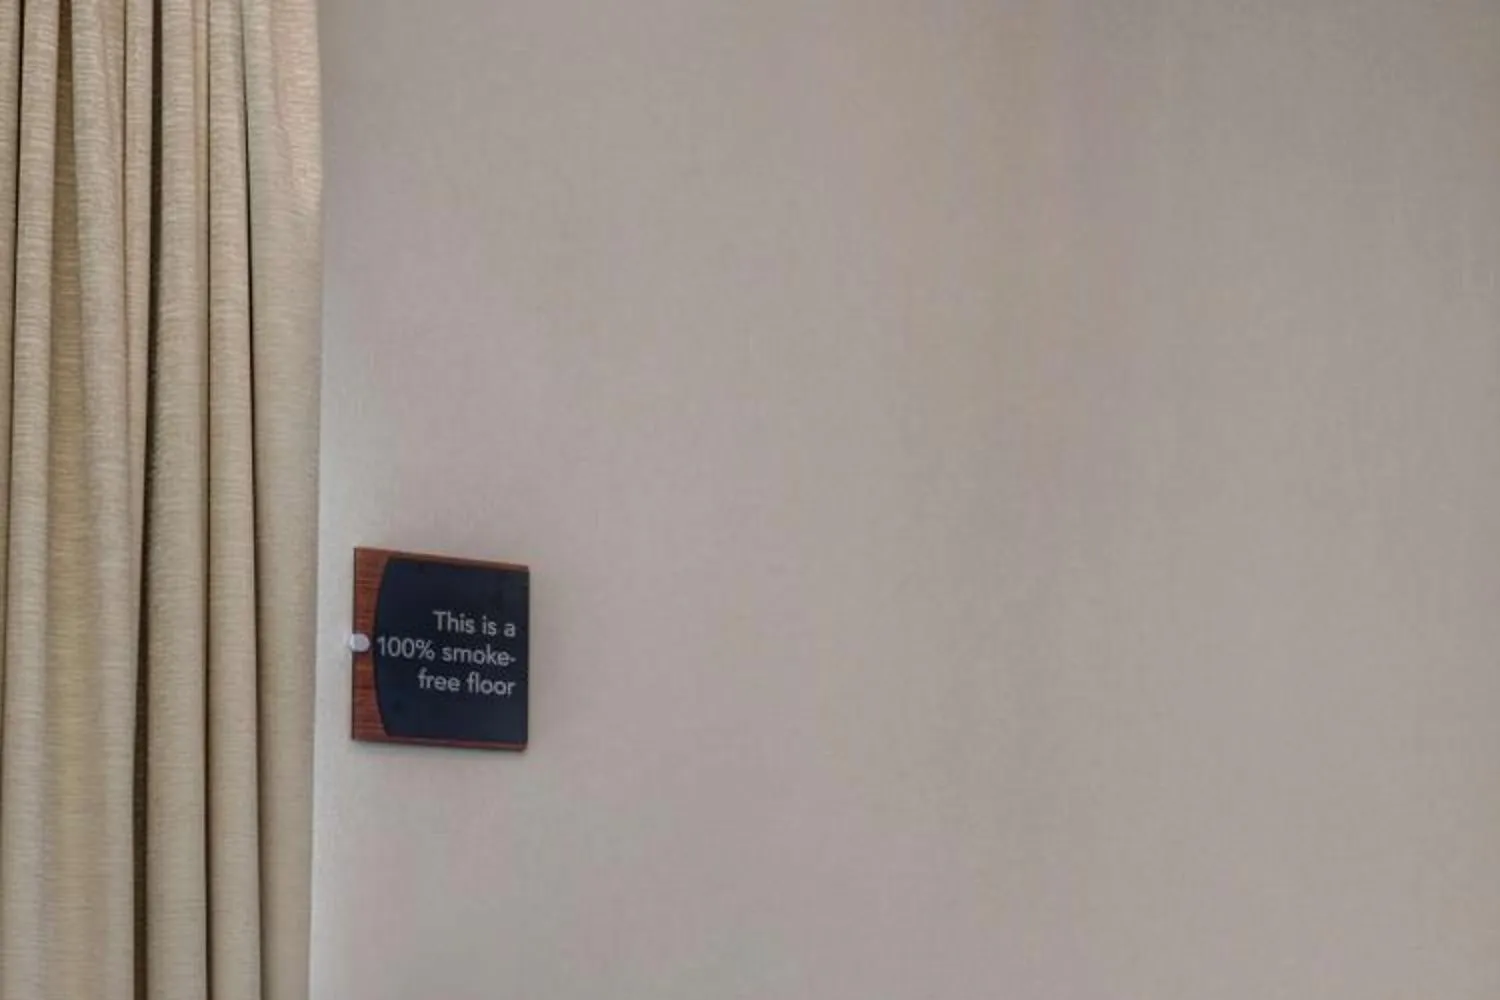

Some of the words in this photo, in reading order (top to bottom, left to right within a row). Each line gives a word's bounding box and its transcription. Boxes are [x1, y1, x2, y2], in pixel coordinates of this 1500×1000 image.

[432, 609, 475, 635] This
[482, 615, 498, 636] is
[503, 622, 517, 638] a
[377, 635, 435, 661] 100%
[442, 643, 517, 667] smoke-
[418, 667, 461, 692] free
[466, 671, 517, 696] floor
